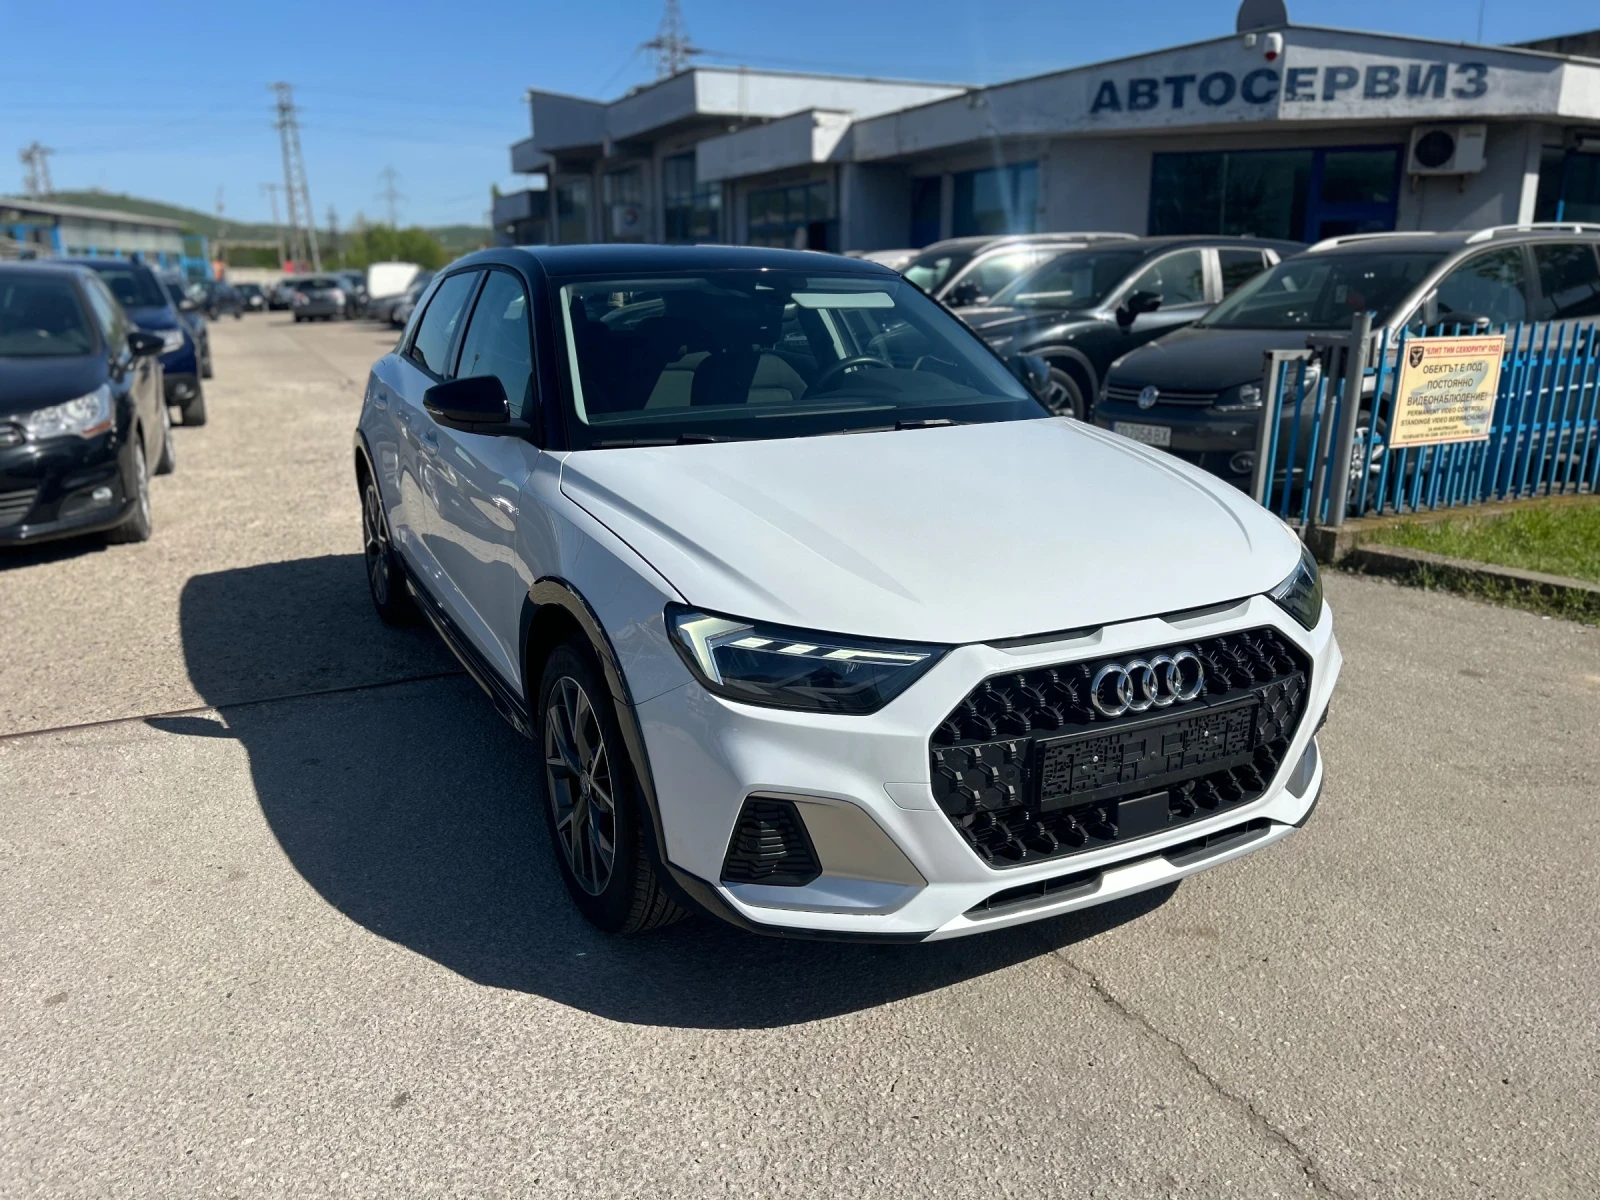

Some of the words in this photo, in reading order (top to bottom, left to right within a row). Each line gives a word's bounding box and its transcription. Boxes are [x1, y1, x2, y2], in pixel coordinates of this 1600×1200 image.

[1090, 62, 1488, 114] АВТОСЕРВИЗ
[1423, 363, 1459, 374] ОБЕКТЪТ
[1460, 363, 1465, 372] Е
[1466, 362, 1483, 373] ПОД
[1427, 378, 1474, 390] ПОСТОЯННО
[1407, 392, 1488, 407] ВИДЕОНАБЛЮДЕНИЕ!
[1407, 408, 1440, 417] PERMANENT
[1441, 406, 1457, 414] VIDEO
[1432, 416, 1448, 424] VIDEO
